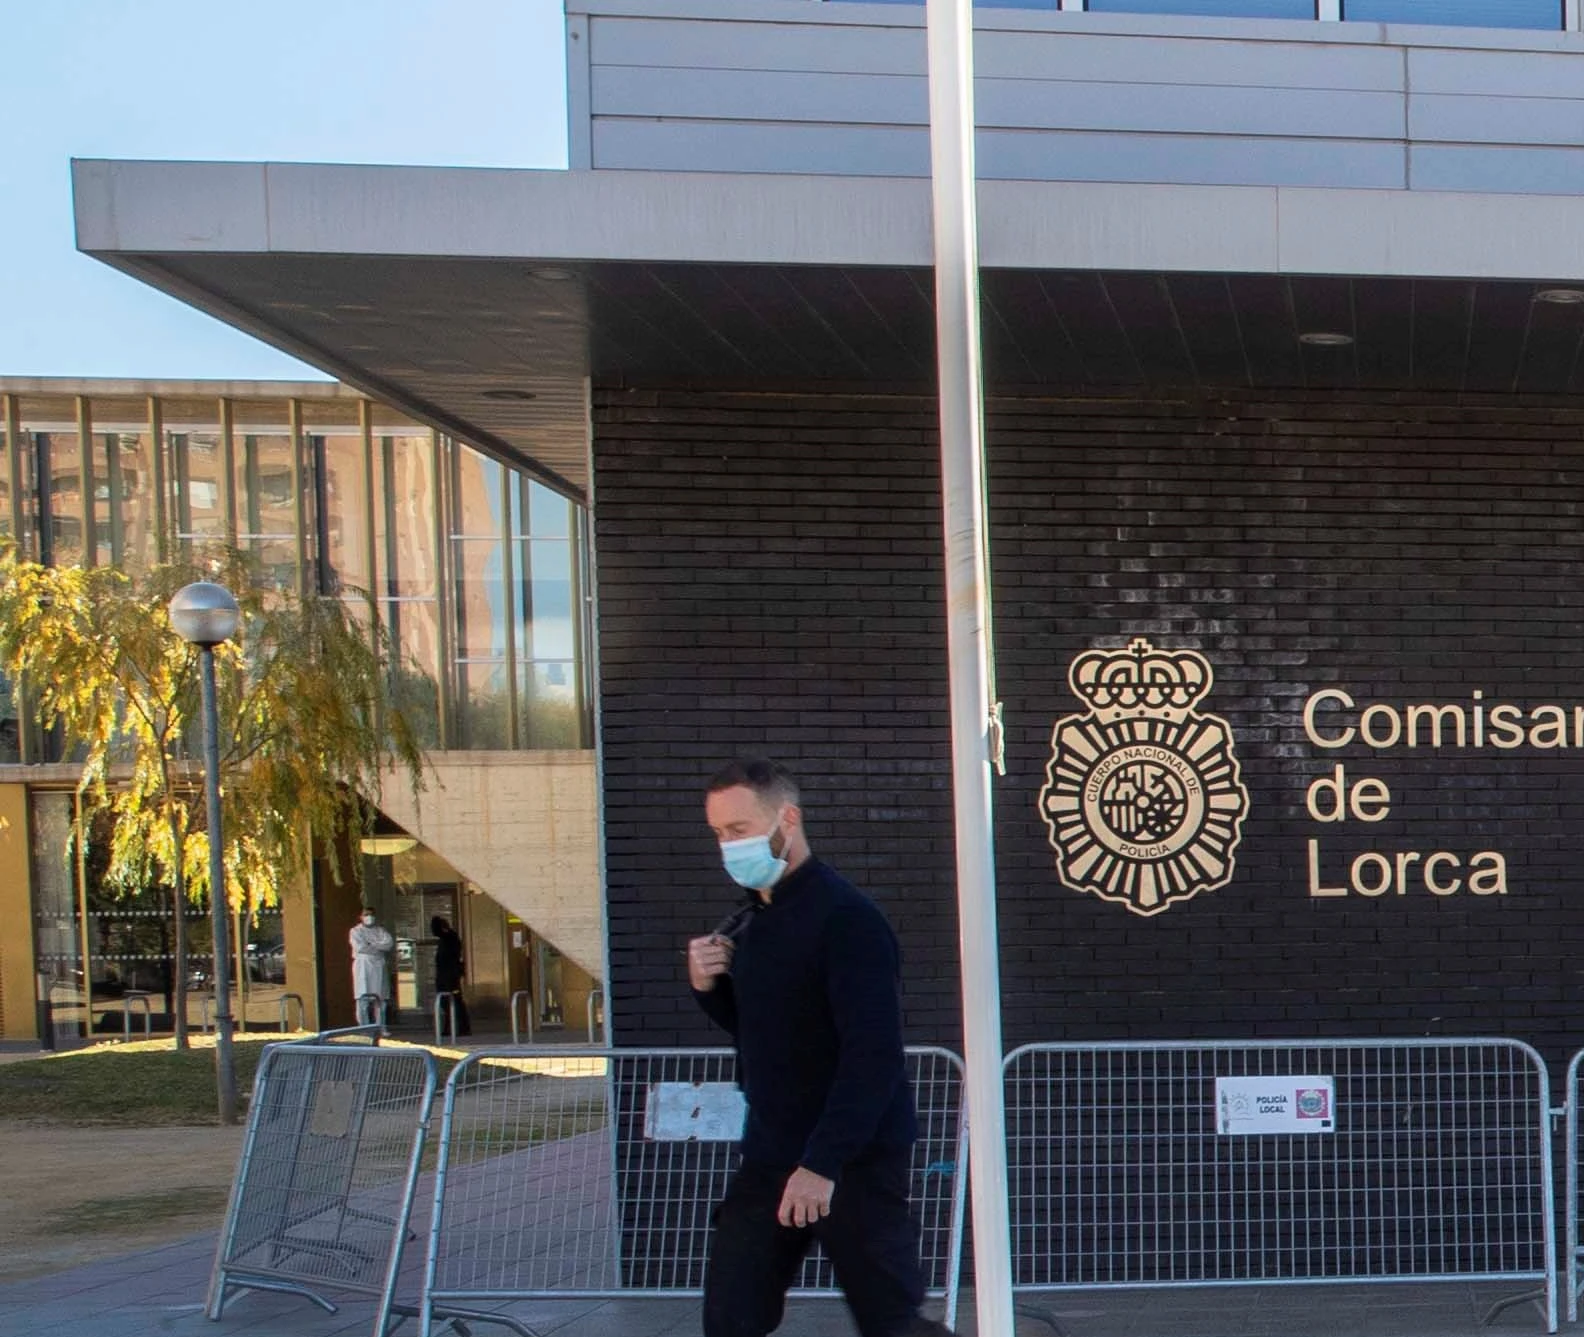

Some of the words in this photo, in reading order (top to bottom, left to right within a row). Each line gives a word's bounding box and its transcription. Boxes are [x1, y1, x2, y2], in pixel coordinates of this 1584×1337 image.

[1087, 754, 1121, 802] CUERPO
[1124, 747, 1187, 778] NACIONAL
[1186, 777, 1200, 795] DE
[1306, 764, 1391, 822] de
[1119, 843, 1171, 858] POLICÍA
[1308, 839, 1508, 897] Lorca
[1256, 1093, 1288, 1104] POLICÍA
[1259, 1105, 1286, 1114] LOCAL
